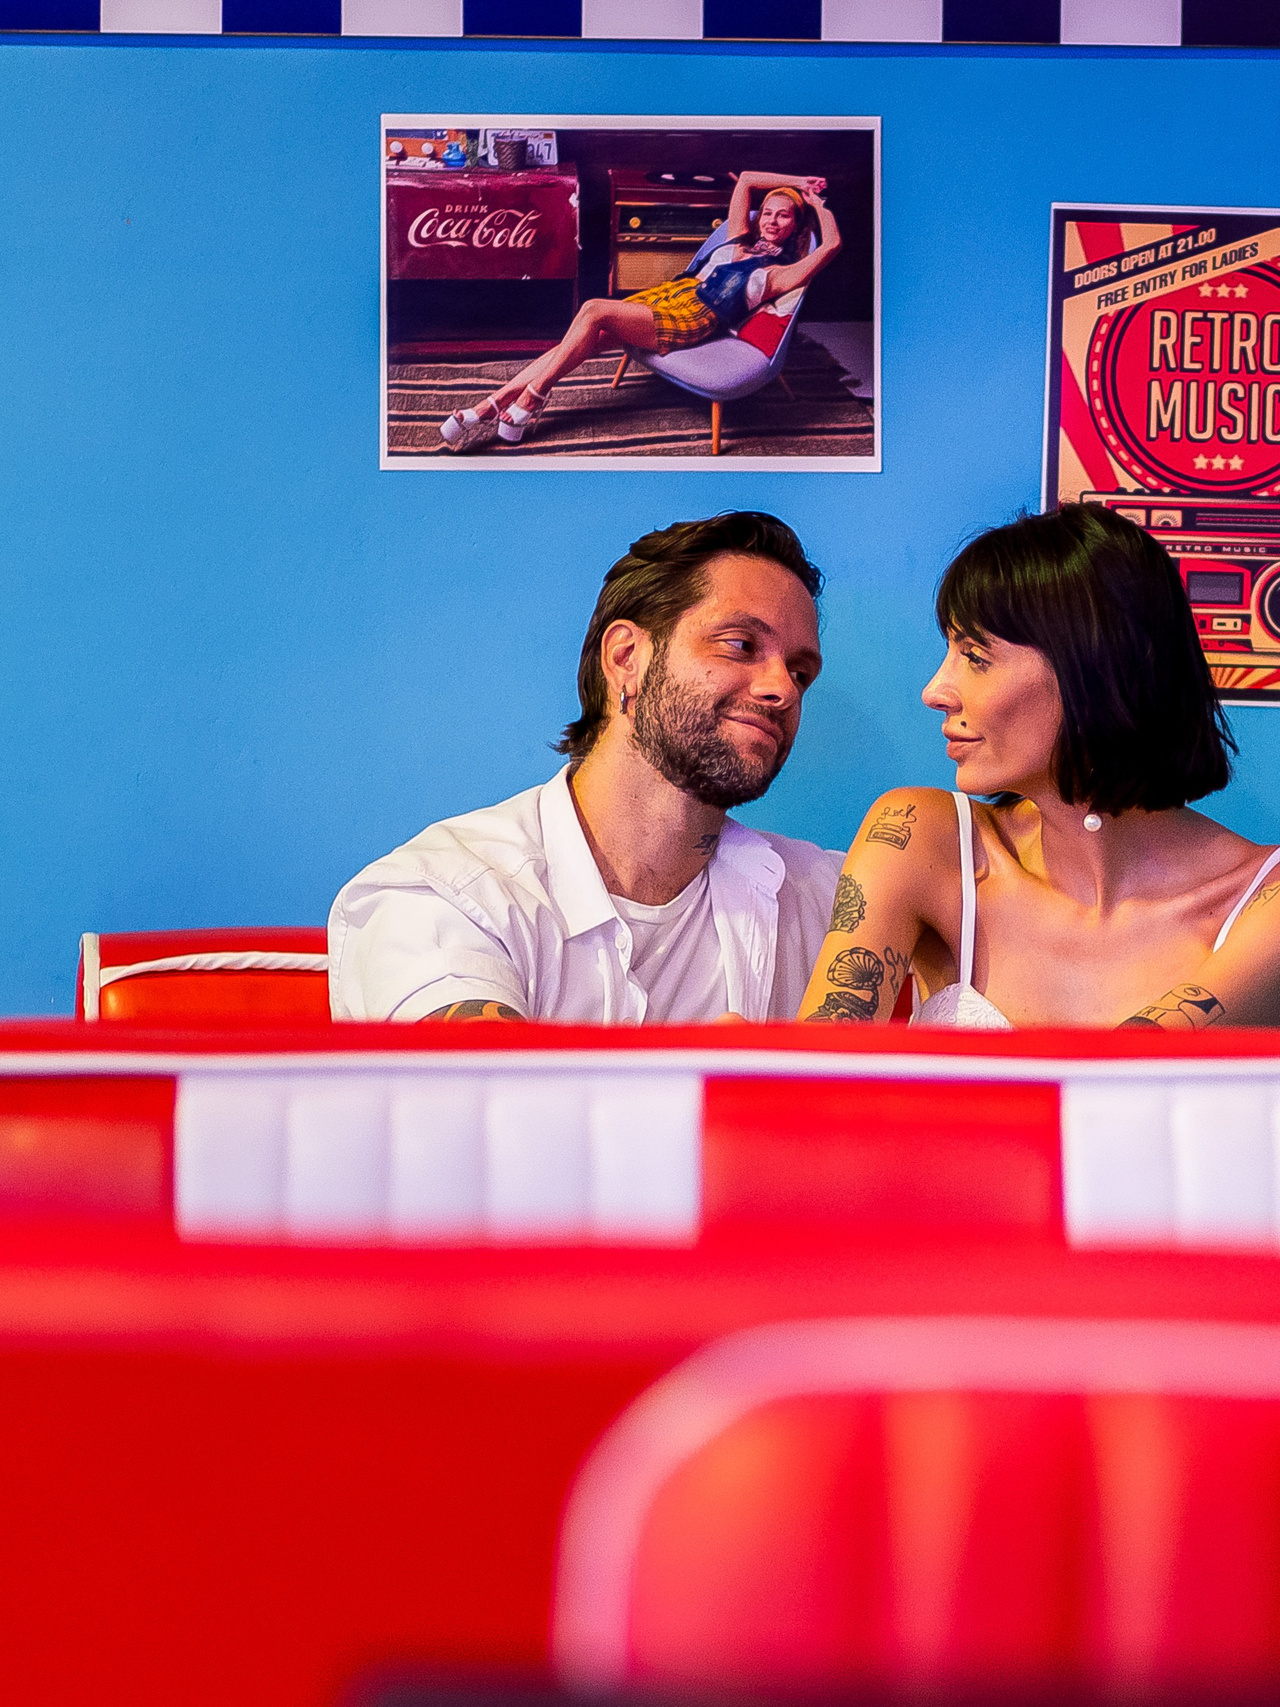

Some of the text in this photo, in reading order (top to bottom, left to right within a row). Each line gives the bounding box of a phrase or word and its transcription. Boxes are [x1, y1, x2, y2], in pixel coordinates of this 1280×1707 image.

[407, 207, 543, 249] Coca-Cola
[444, 205, 489, 214] DRINK
[1074, 227, 1217, 289] DOORS OPEN AT 21.00
[1097, 242, 1259, 310] FREE ENTRY FOR LADIES
[1165, 544, 1267, 553] RETRO MUSIC
